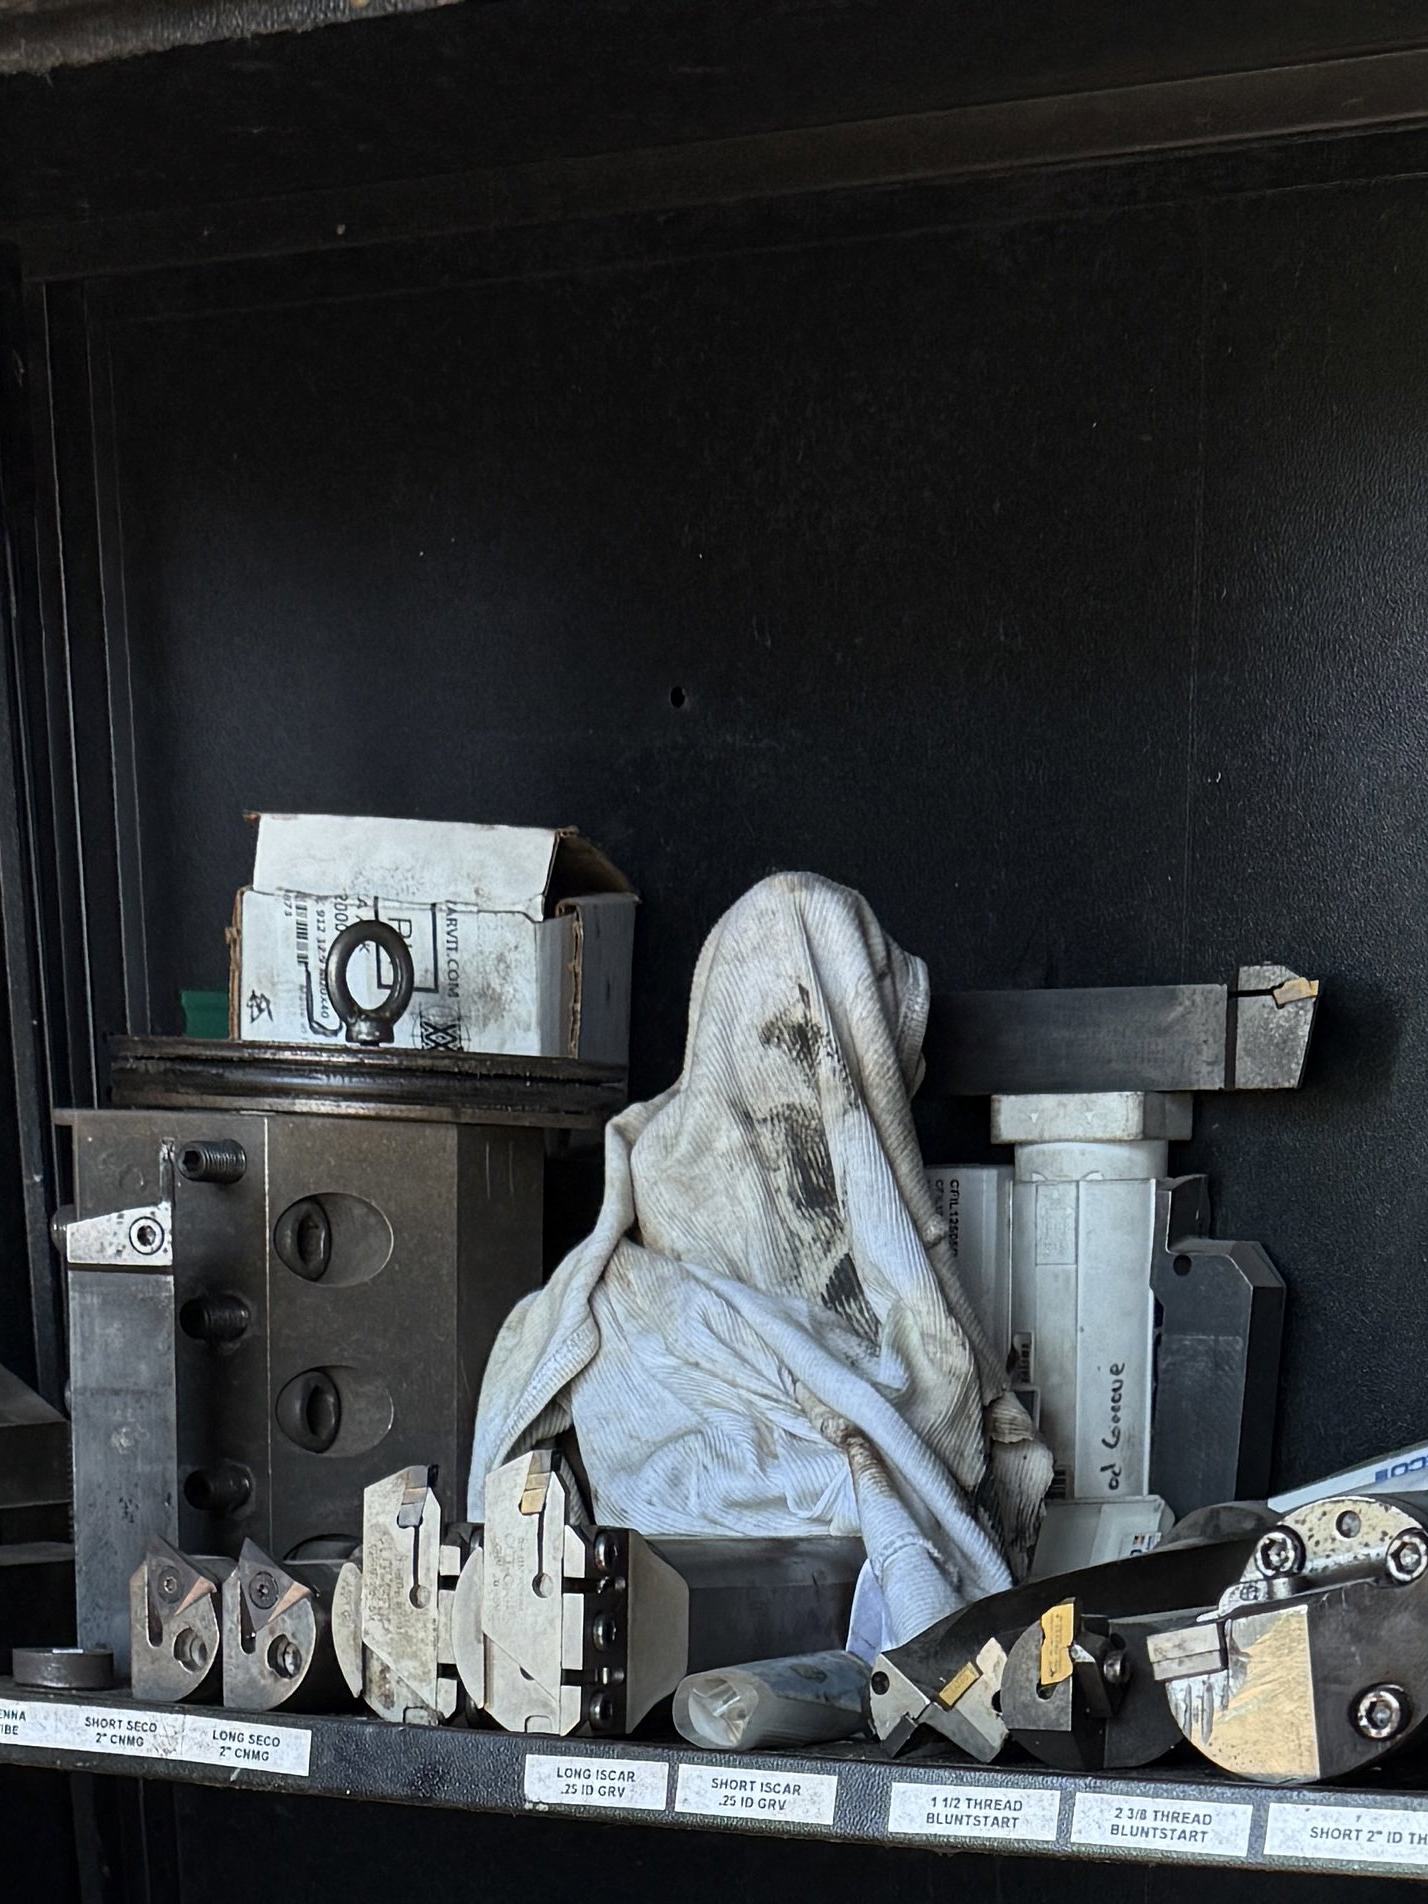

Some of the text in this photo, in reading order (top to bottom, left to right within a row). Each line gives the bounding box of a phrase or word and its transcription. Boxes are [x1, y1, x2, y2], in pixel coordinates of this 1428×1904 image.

[85, 1716, 158, 1733] SHORT SECO
[110, 1733, 145, 1748] CNMG
[212, 1729, 281, 1748] LONG SECO
[234, 1746, 270, 1762] CNMG
[556, 1766, 636, 1784] LONG ISCAR
[560, 1783, 626, 1799] .25 ID GRV
[710, 1777, 802, 1796] SHORT ISCAR
[718, 1795, 787, 1812] .25 ID GRV
[931, 1797, 1023, 1813] 1 1/2 THREAD
[926, 1812, 1020, 1829] BLUNTSTART
[1114, 1807, 1213, 1826] 2 3/8 THREAD
[1110, 1823, 1209, 1843] BLUNTSTART
[1309, 1826, 1362, 1842] SHORT
[1387, 1830, 1403, 1845] ID
